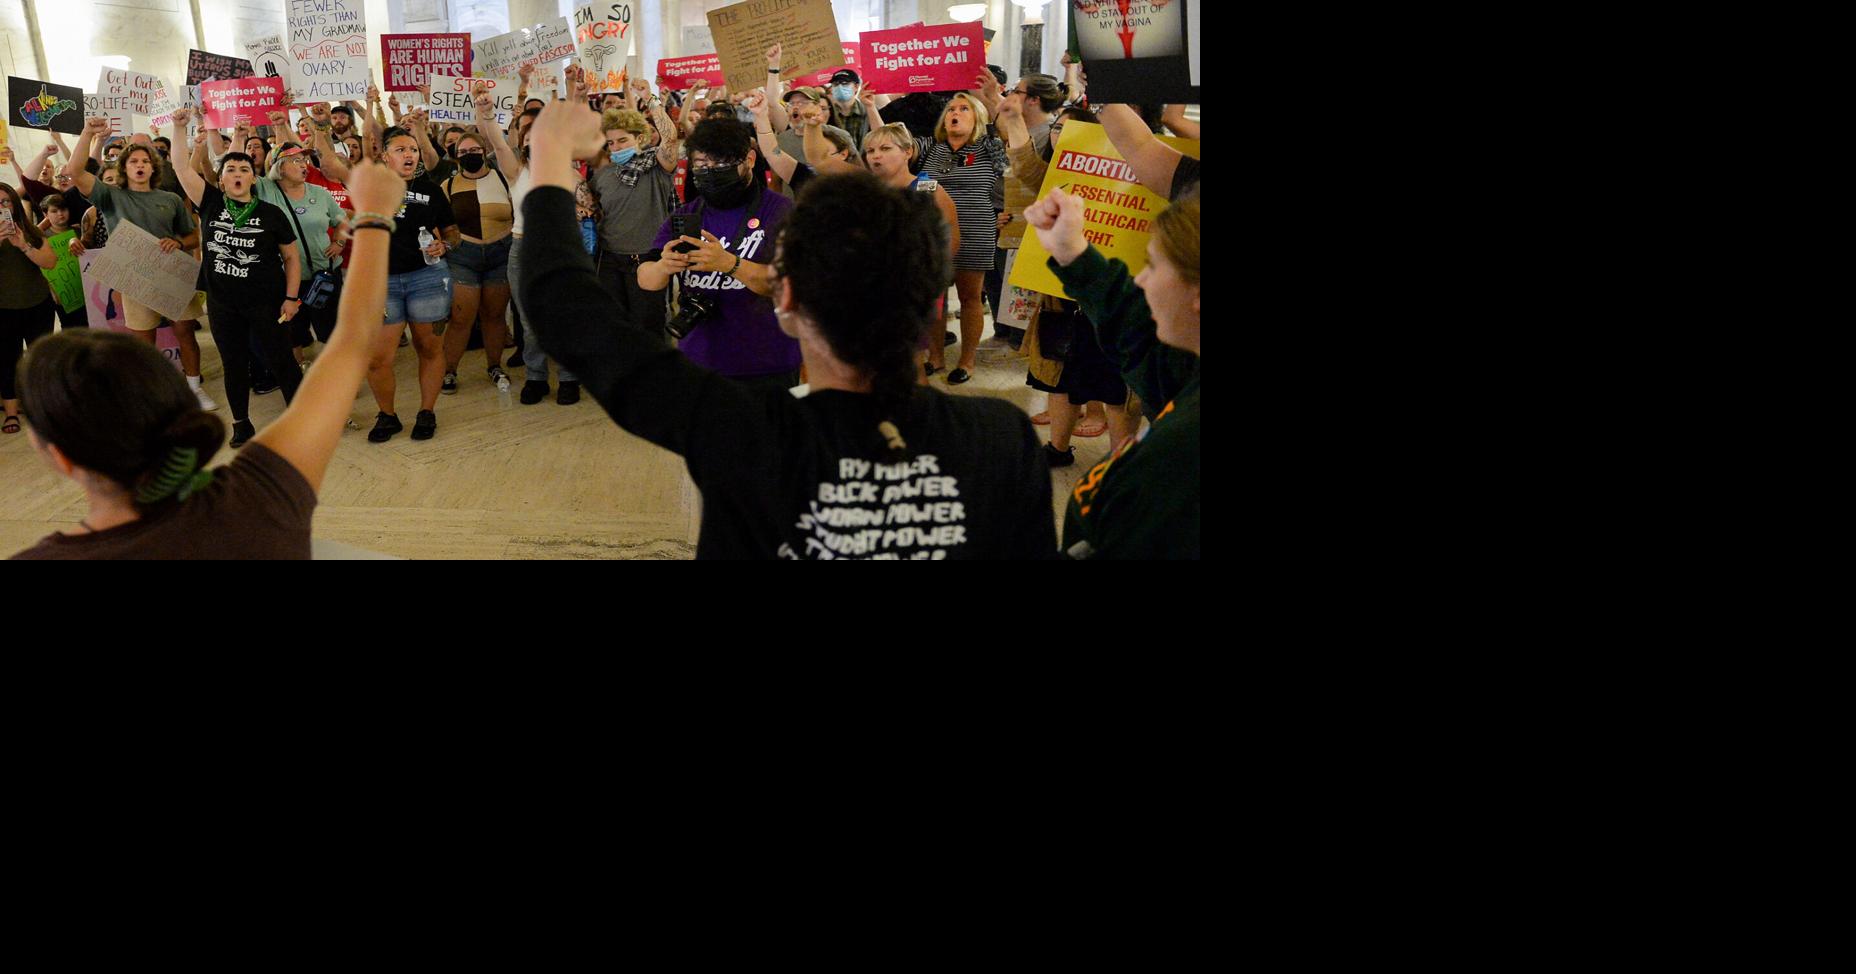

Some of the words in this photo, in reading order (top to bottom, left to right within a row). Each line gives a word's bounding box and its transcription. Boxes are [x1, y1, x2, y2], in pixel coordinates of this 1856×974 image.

[291, 0, 345, 16] FEWER
[607, 4, 630, 23] SO
[1088, 10, 1099, 19] TO
[1100, 8, 1124, 18] STAY
[1127, 5, 1146, 15] OUT
[1150, 4, 1164, 13] OF
[289, 14, 327, 28] RIGHTS
[330, 11, 358, 22] THAN
[1100, 20, 1113, 29] MY
[1116, 17, 1151, 28] VAGINA
[293, 27, 313, 42] MY
[578, 22, 629, 44] NGRY
[293, 48, 313, 61] WE
[319, 44, 340, 59] ARE
[346, 42, 367, 56] NOT
[388, 39, 430, 50] WOMEN'S
[432, 37, 464, 49] RIGHTS
[870, 38, 940, 56] Together
[942, 35, 970, 48] We
[389, 50, 415, 64] ARE
[416, 48, 464, 63] HUMAN
[665, 59, 707, 68] Together
[875, 55, 915, 71] Fight
[916, 53, 940, 66] for
[944, 50, 968, 64] All
[391, 64, 464, 87] RIGHTS
[666, 68, 690, 77] Fight
[692, 65, 706, 73] for
[208, 87, 255, 99] Together
[256, 85, 276, 94] We
[309, 80, 368, 97] ACTING!
[83, 96, 129, 110] RO-LIFE
[212, 99, 237, 112] Fight
[238, 98, 256, 108] for
[258, 96, 275, 107] All
[431, 91, 514, 110] STEANG
[430, 109, 471, 121] HEALTH
[1058, 152, 1139, 182] ABORTIO
[1070, 183, 1151, 212] ESSENTIAL.
[1083, 207, 1155, 233] ALTHCAR
[213, 230, 256, 248] Trans
[1082, 227, 1115, 248] GHT.
[213, 259, 249, 278] Kids
[818, 481, 880, 503] BLCK
[882, 476, 960, 504] PWER
[886, 502, 966, 525] POWER
[881, 526, 967, 549] POWER
